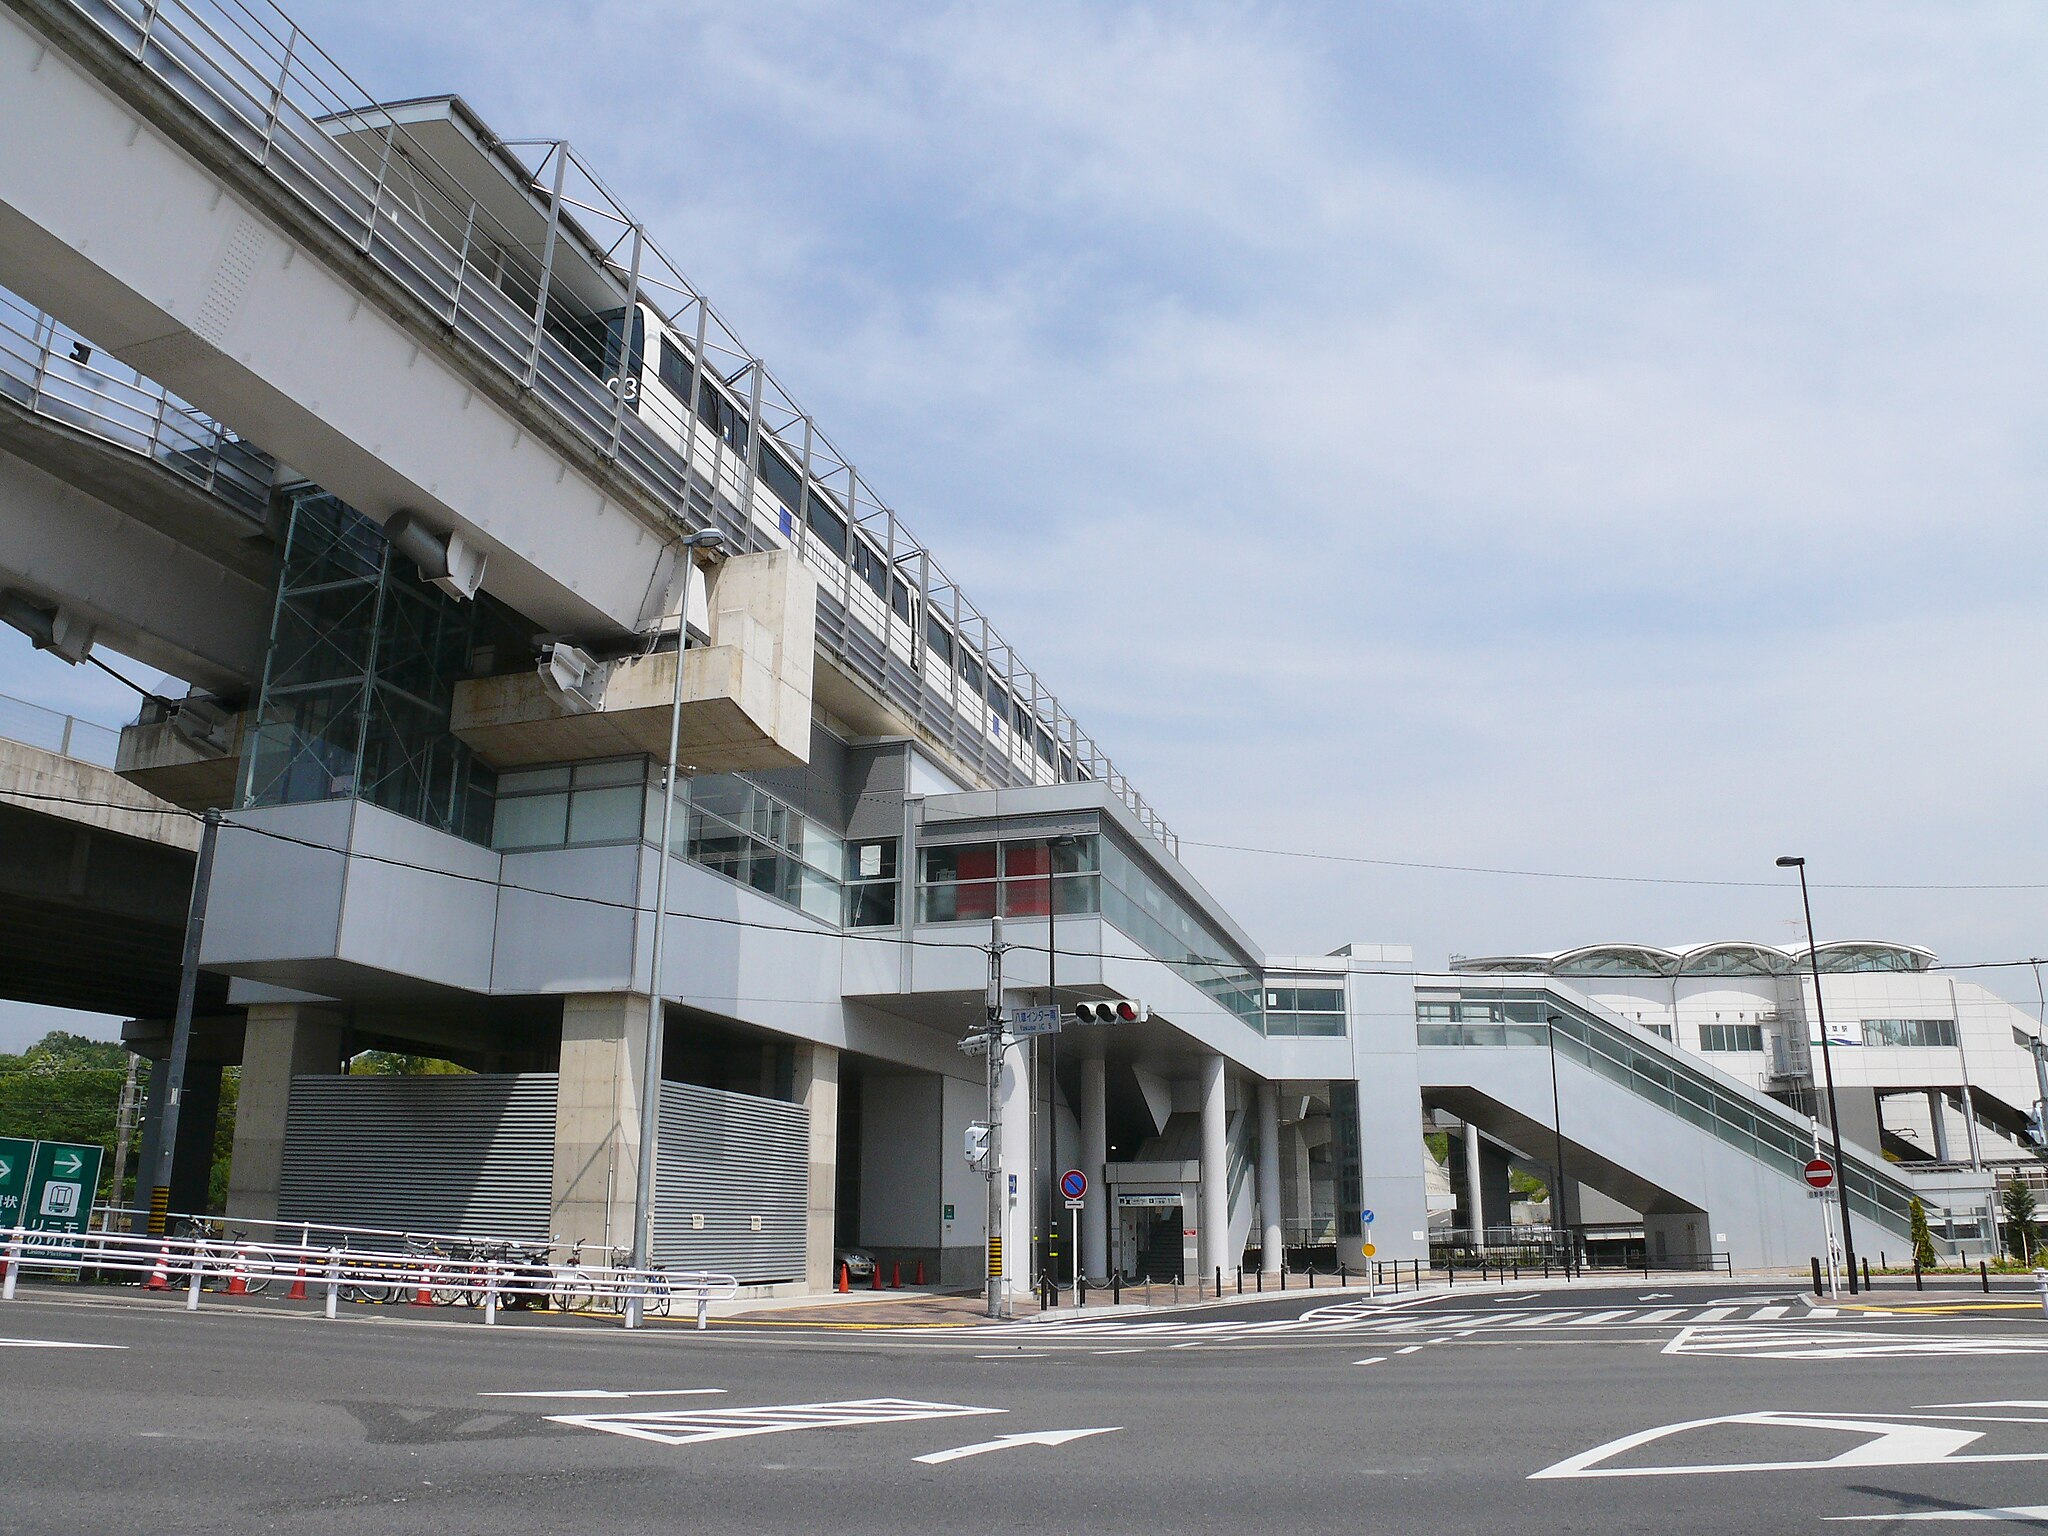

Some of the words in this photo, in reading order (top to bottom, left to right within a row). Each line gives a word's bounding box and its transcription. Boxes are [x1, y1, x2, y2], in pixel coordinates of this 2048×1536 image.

[0, 1194, 18, 1209] 状
[31, 1218, 79, 1233] リニモ
